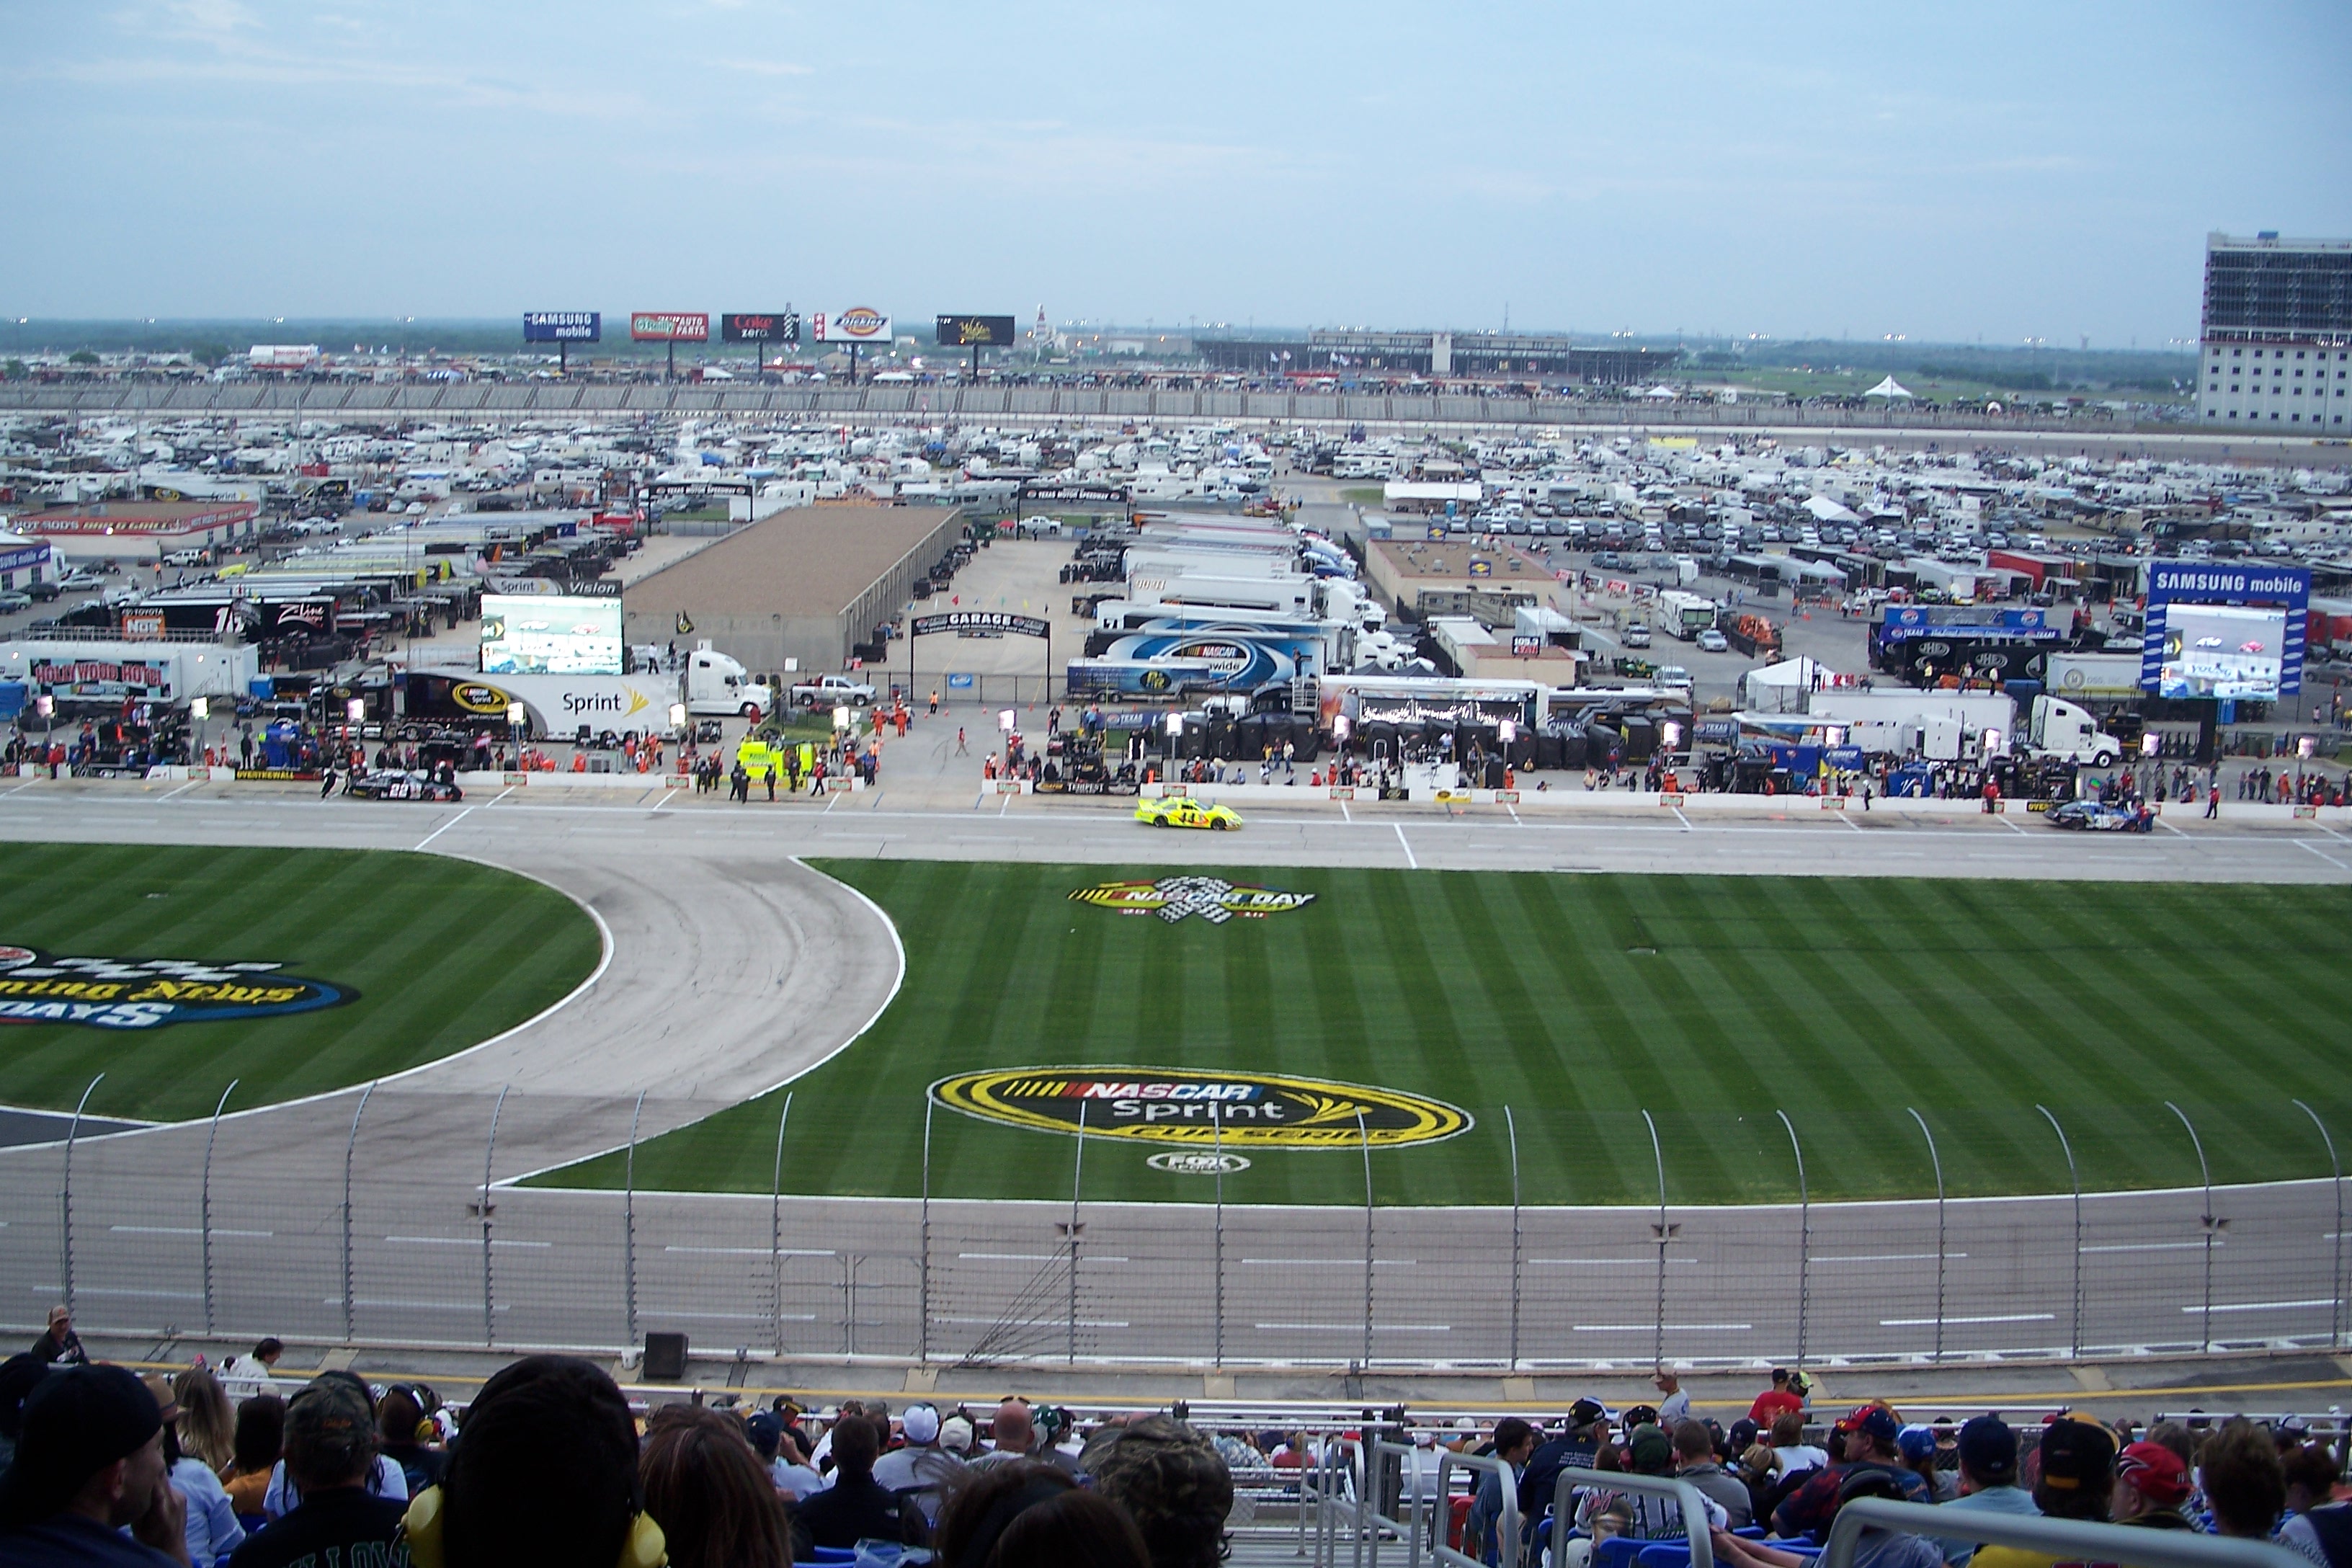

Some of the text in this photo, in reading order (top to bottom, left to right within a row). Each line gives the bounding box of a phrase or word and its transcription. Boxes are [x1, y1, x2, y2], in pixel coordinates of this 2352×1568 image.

[531, 313, 592, 325] SAMSUNG
[679, 316, 703, 326] AUTO
[734, 315, 774, 329] Coke
[841, 317, 885, 326] Dickies
[556, 325, 592, 337] mobile
[676, 326, 705, 336] PARTS
[500, 580, 615, 594] Sprint Vision
[2156, 571, 2303, 594] SAMSUNG mobile
[949, 612, 1012, 625] GARAGE
[1202, 646, 1237, 658] NASCAR
[35, 663, 163, 687] HOLLYWOOD HOTEL
[563, 692, 623, 716] Sprint
[1121, 713, 1144, 723] TEXAS
[1705, 723, 1729, 734] TEXAS
[1124, 890, 1317, 905] NASCAR DAY
[1082, 1082, 1253, 1100] NASCAR
[1112, 1099, 1285, 1122] Sprint
